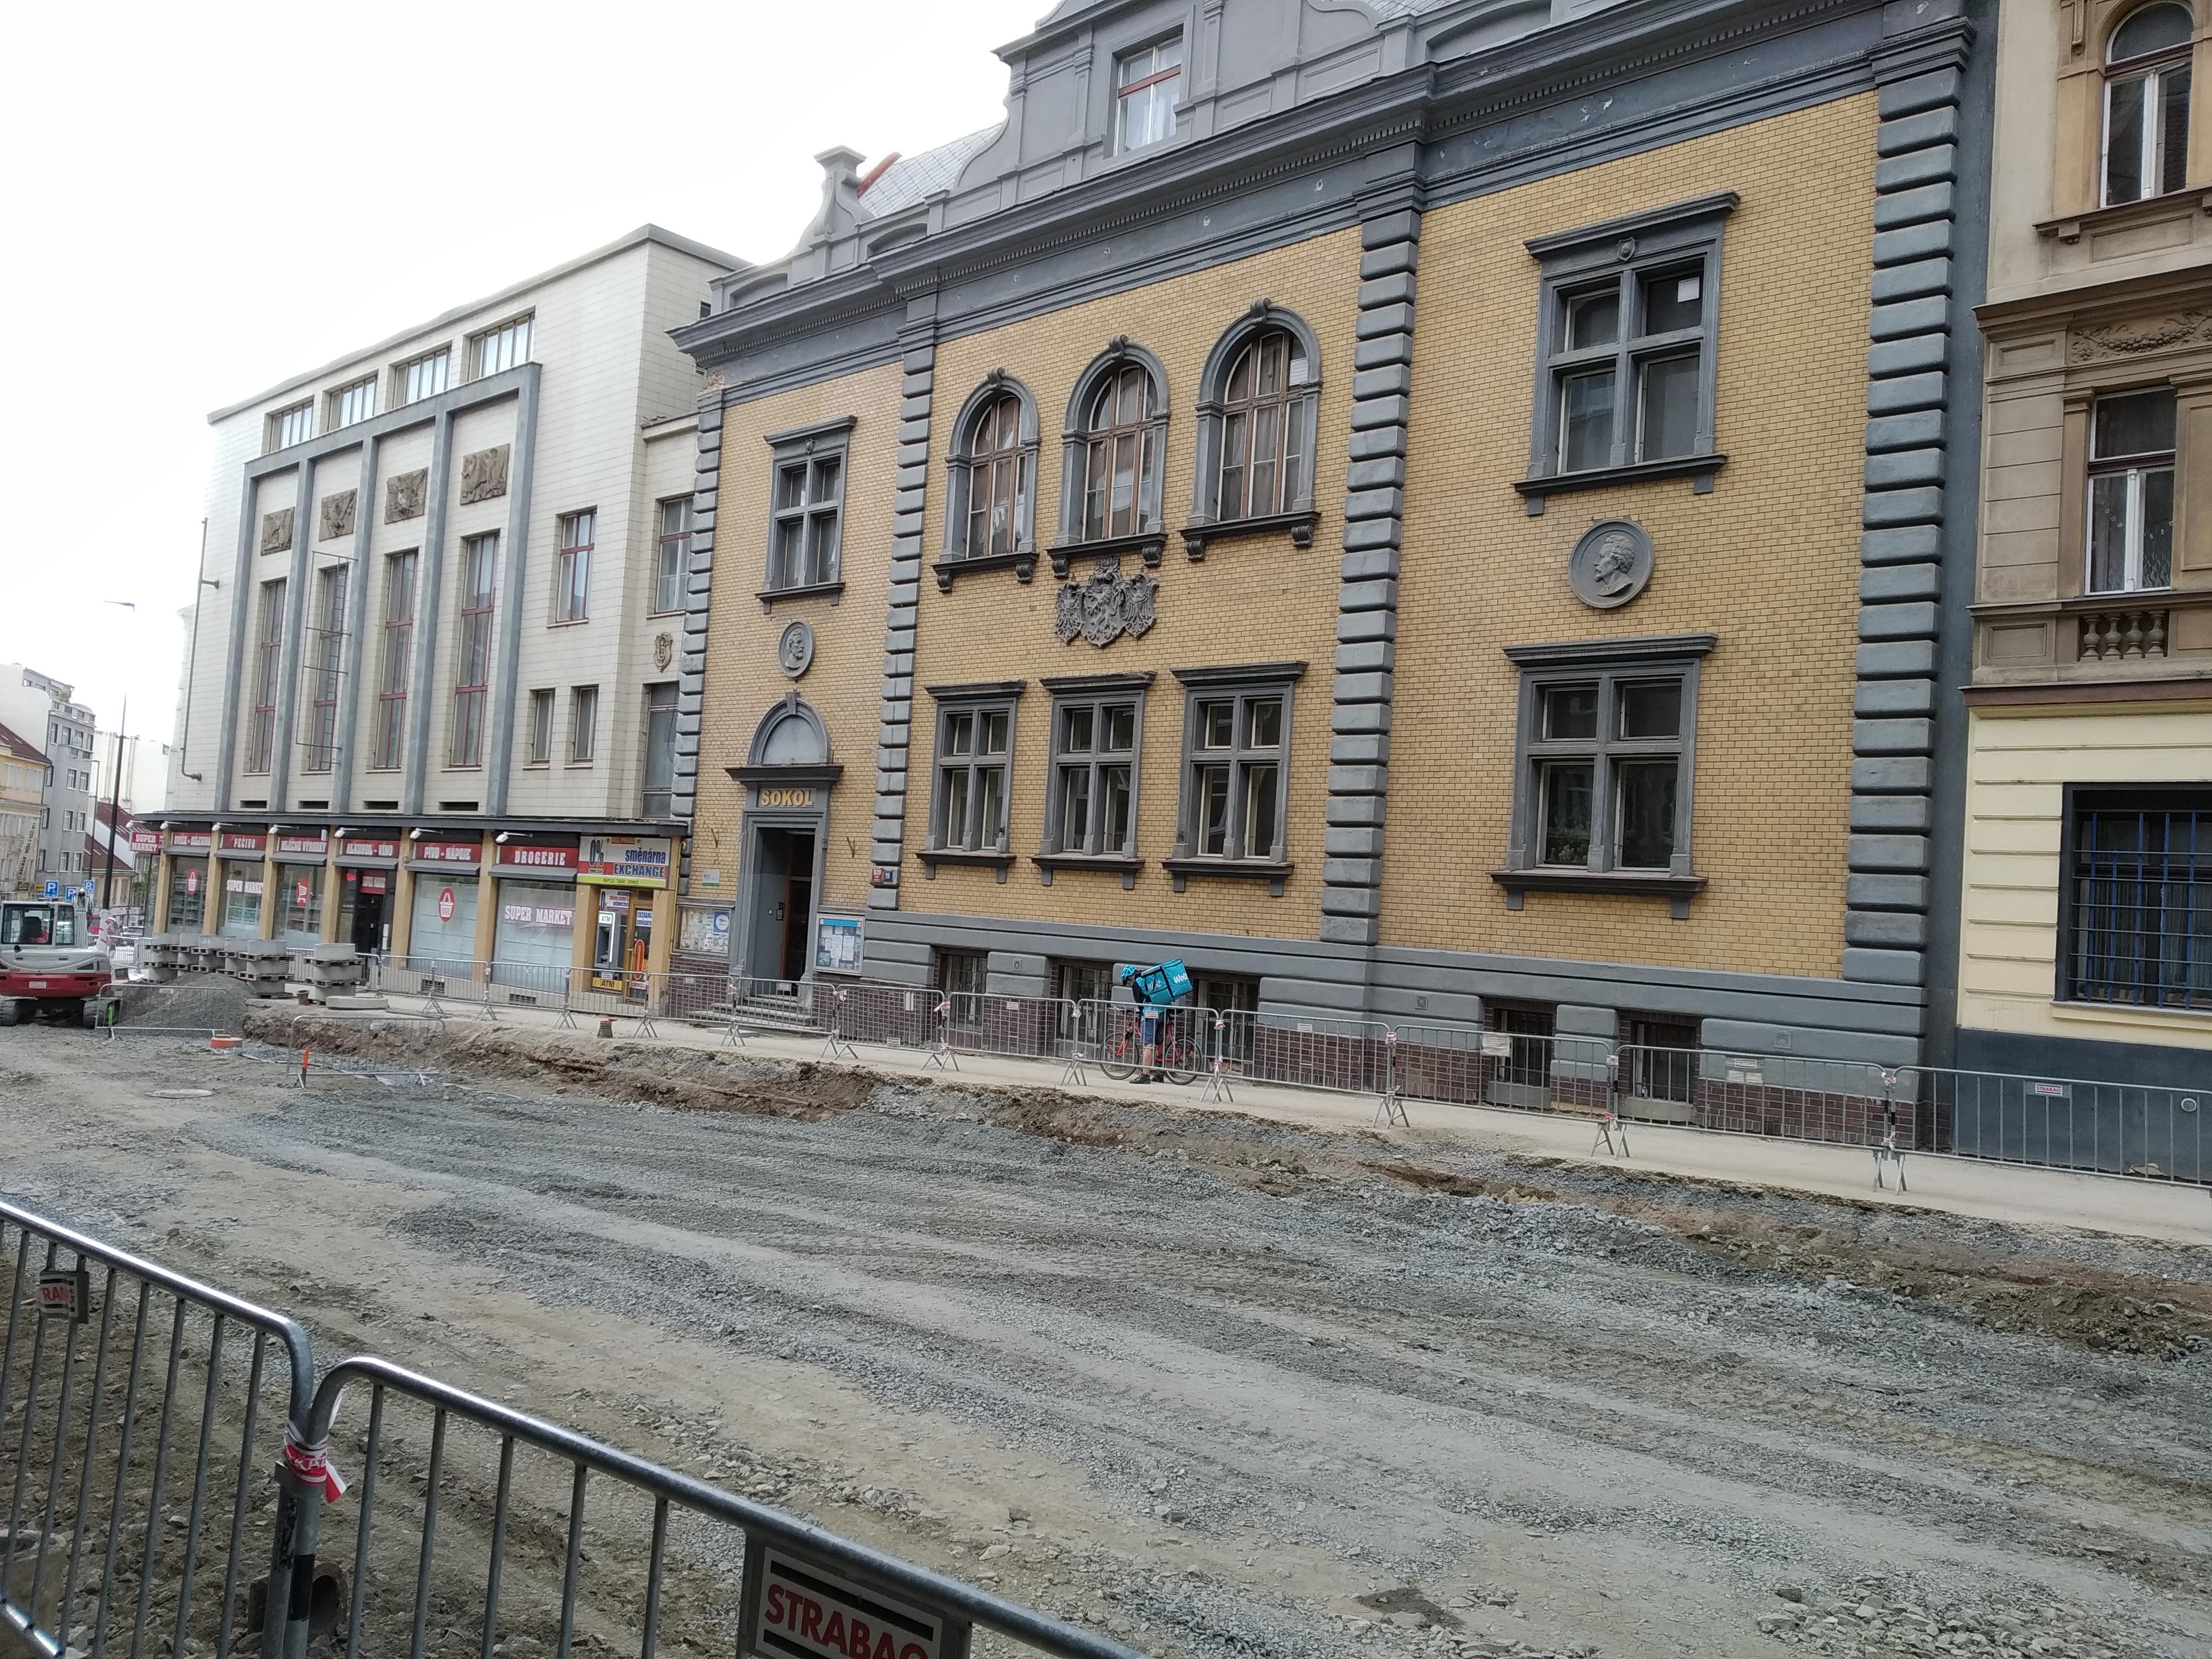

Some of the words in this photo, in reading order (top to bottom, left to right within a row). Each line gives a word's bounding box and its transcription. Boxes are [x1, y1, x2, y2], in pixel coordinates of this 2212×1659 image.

[761, 789, 814, 806] SOKOL
[135, 834, 156, 843] SUPER
[233, 837, 255, 849] PEČIVO
[132, 843, 158, 852] MARKET
[346, 843, 373, 855] ALKOHOL
[378, 842, 393, 856] VÍNO
[424, 847, 440, 859] PIVO
[445, 845, 472, 860] NÁPOJE
[514, 851, 566, 866] DROGERIE
[625, 847, 666, 864] směnárna
[614, 863, 665, 878] EXCHANGE
[48, 883, 55, 892] P
[226, 879, 243, 892] SUPER
[244, 881, 263, 894] MARKE
[504, 905, 532, 922] SUPER
[535, 908, 573, 926] MARKET
[601, 979, 615, 988] ATM
[1173, 973, 1189, 984] Wolt
